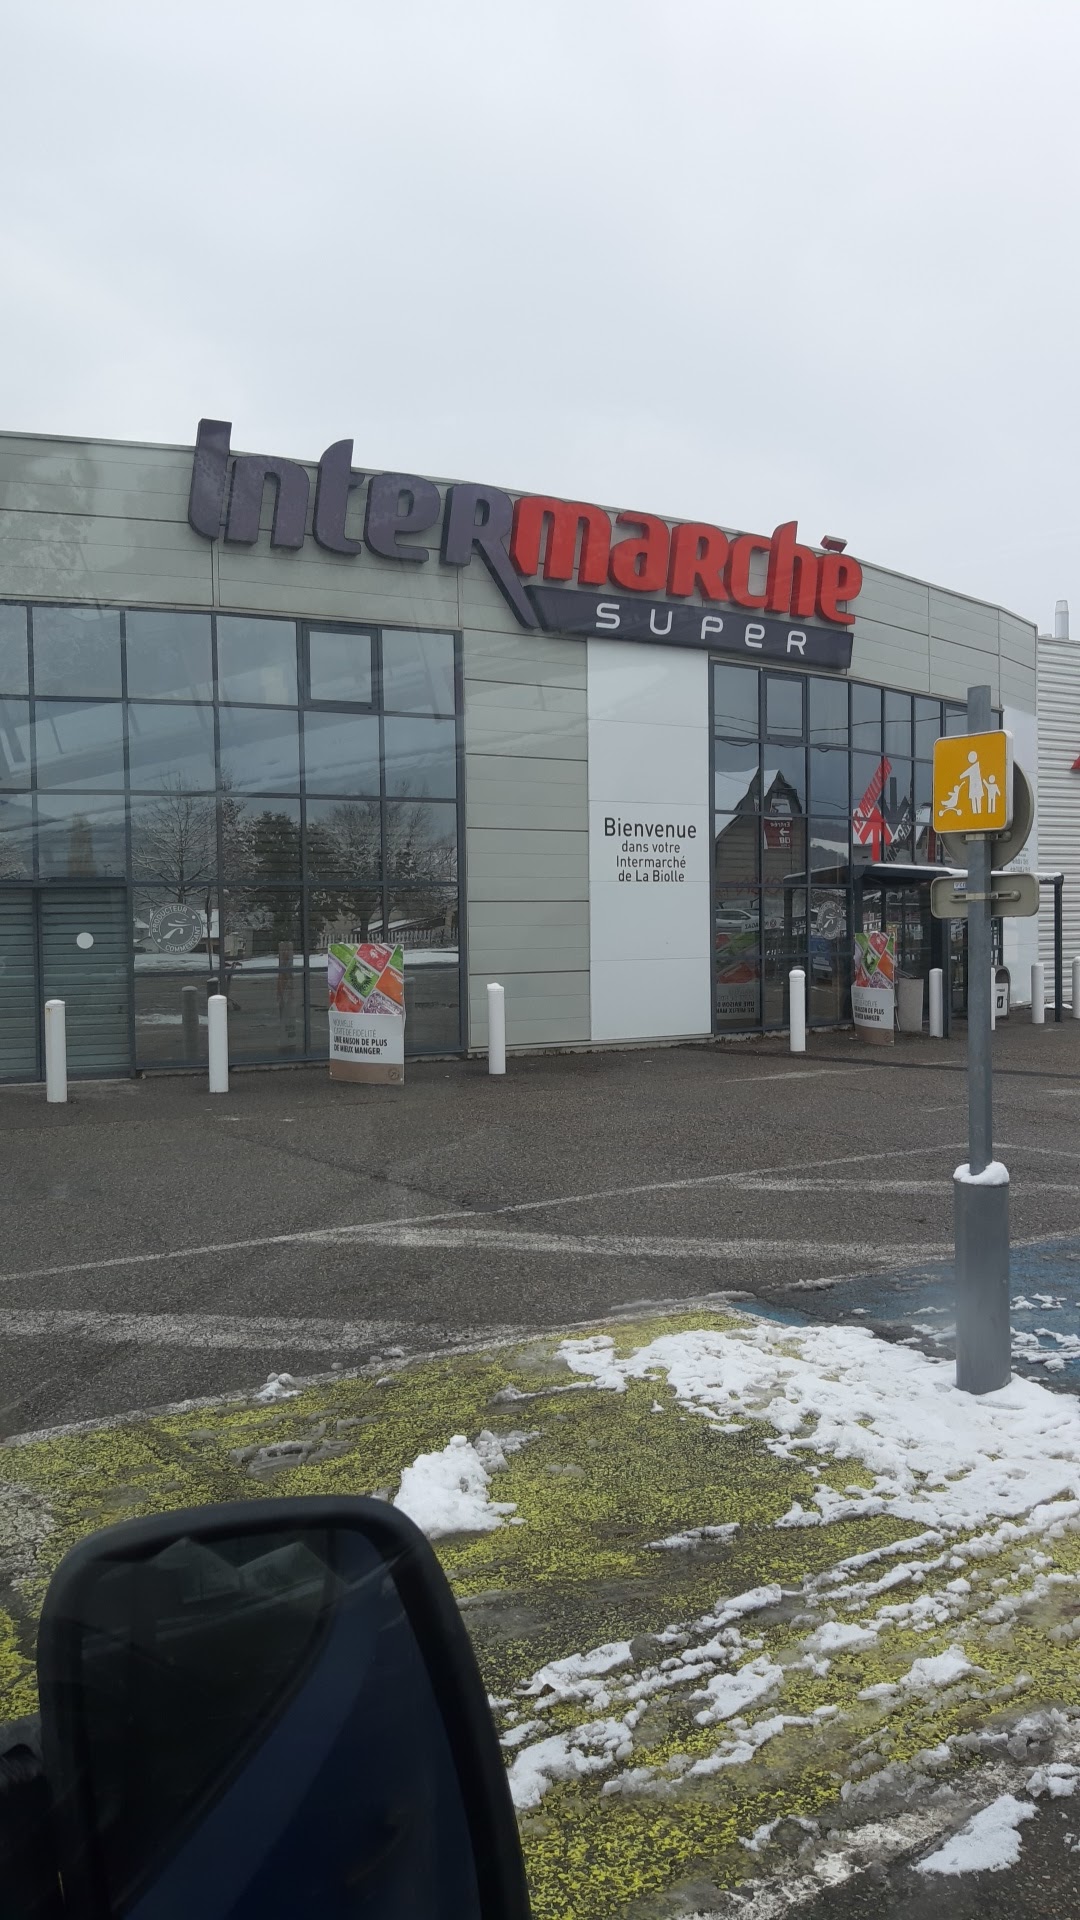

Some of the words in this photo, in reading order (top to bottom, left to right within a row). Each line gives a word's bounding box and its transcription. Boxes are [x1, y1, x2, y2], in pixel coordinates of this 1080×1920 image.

[595, 602, 807, 656] SUPER
[604, 817, 697, 839] Bienvenue
[621, 840, 649, 853] dans
[652, 841, 680, 854] votre
[616, 855, 686, 869] Intermarché
[618, 870, 632, 882] de
[635, 870, 649, 882] La
[652, 870, 685, 882] Biolle
[152, 905, 188, 933] PRODUCTEUR
[165, 926, 201, 952] COMMERÇANT
[361, 1038, 369, 1046] DE
[371, 1039, 388, 1047] PLUS
